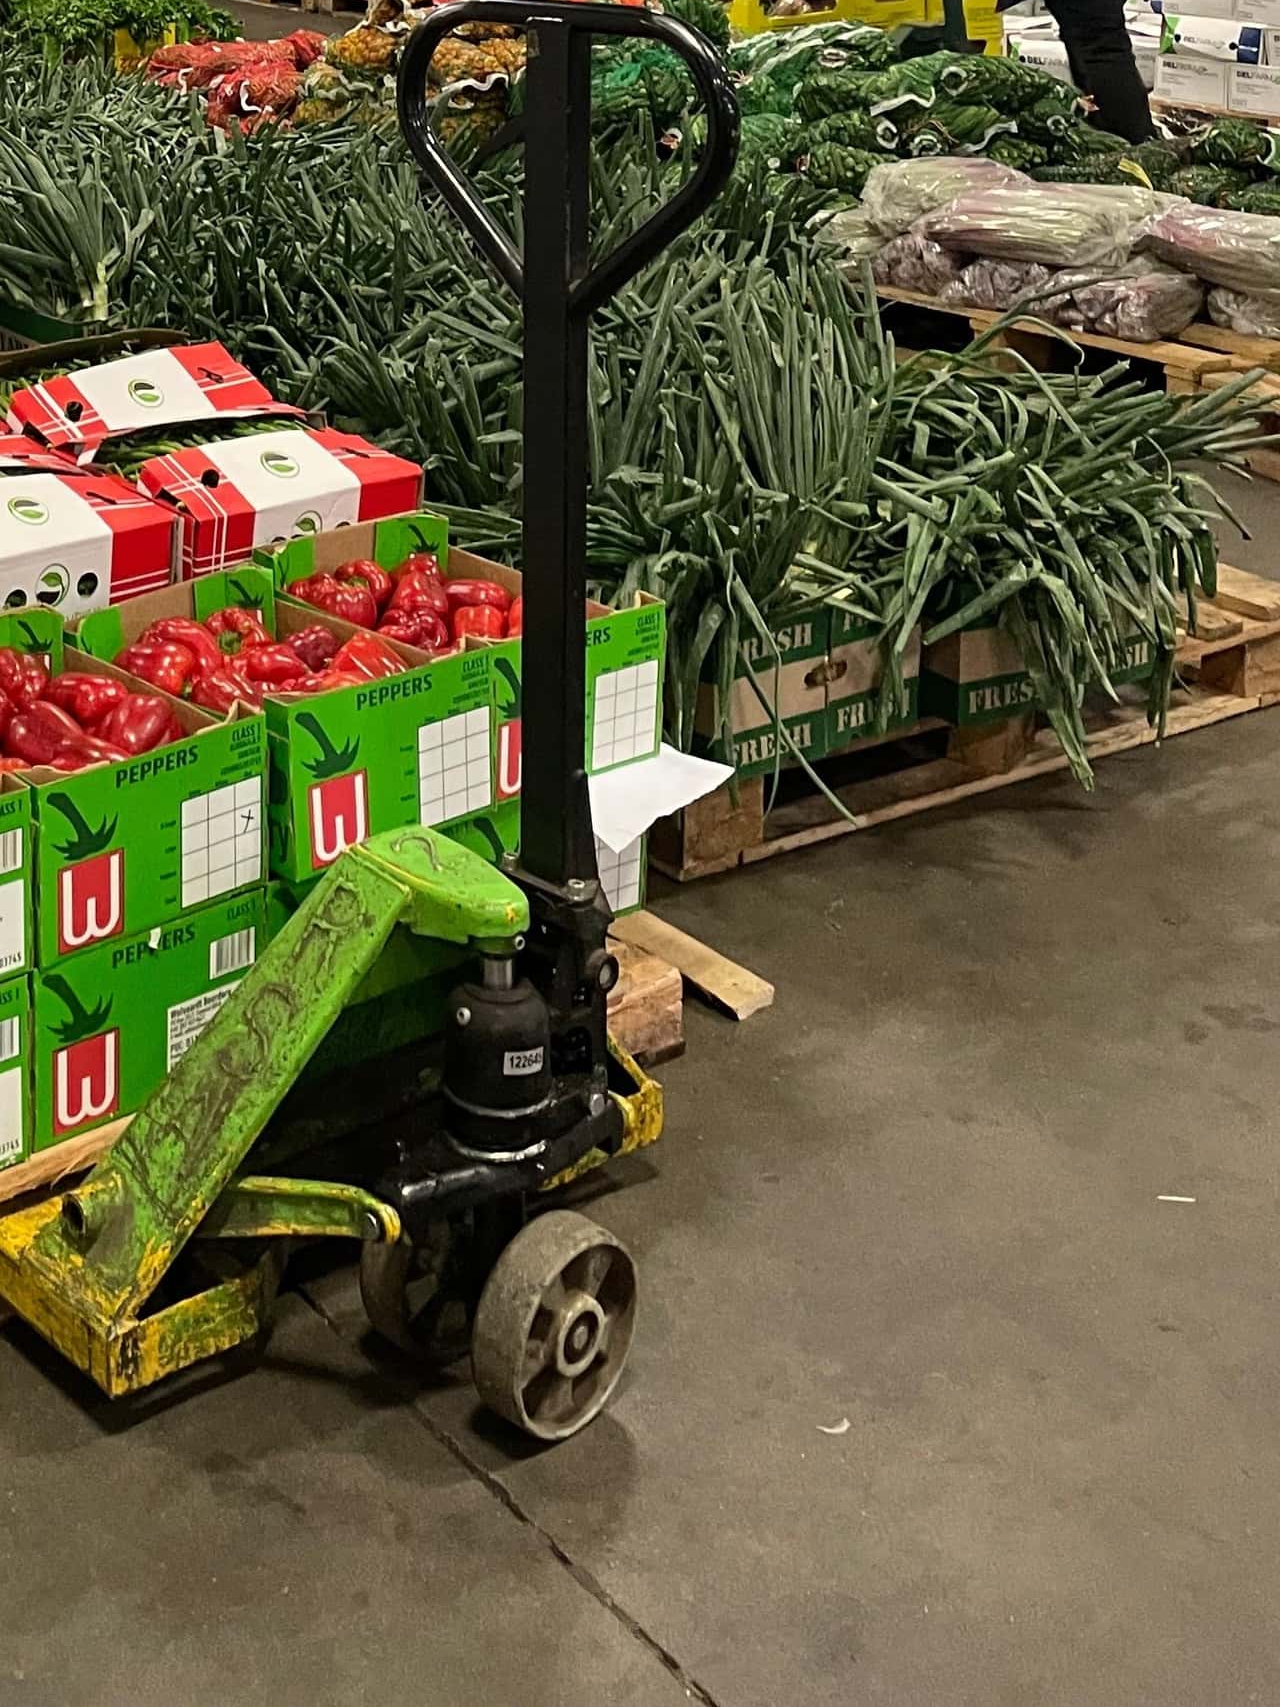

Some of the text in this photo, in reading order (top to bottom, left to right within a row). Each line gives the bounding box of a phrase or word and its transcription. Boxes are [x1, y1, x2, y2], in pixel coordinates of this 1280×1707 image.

[739, 623, 812, 661] RESH
[356, 673, 432, 710] PEPPERS
[969, 679, 1034, 714] FRES
[115, 745, 199, 788] PEPPERS
[113, 924, 196, 969] PEPERS
